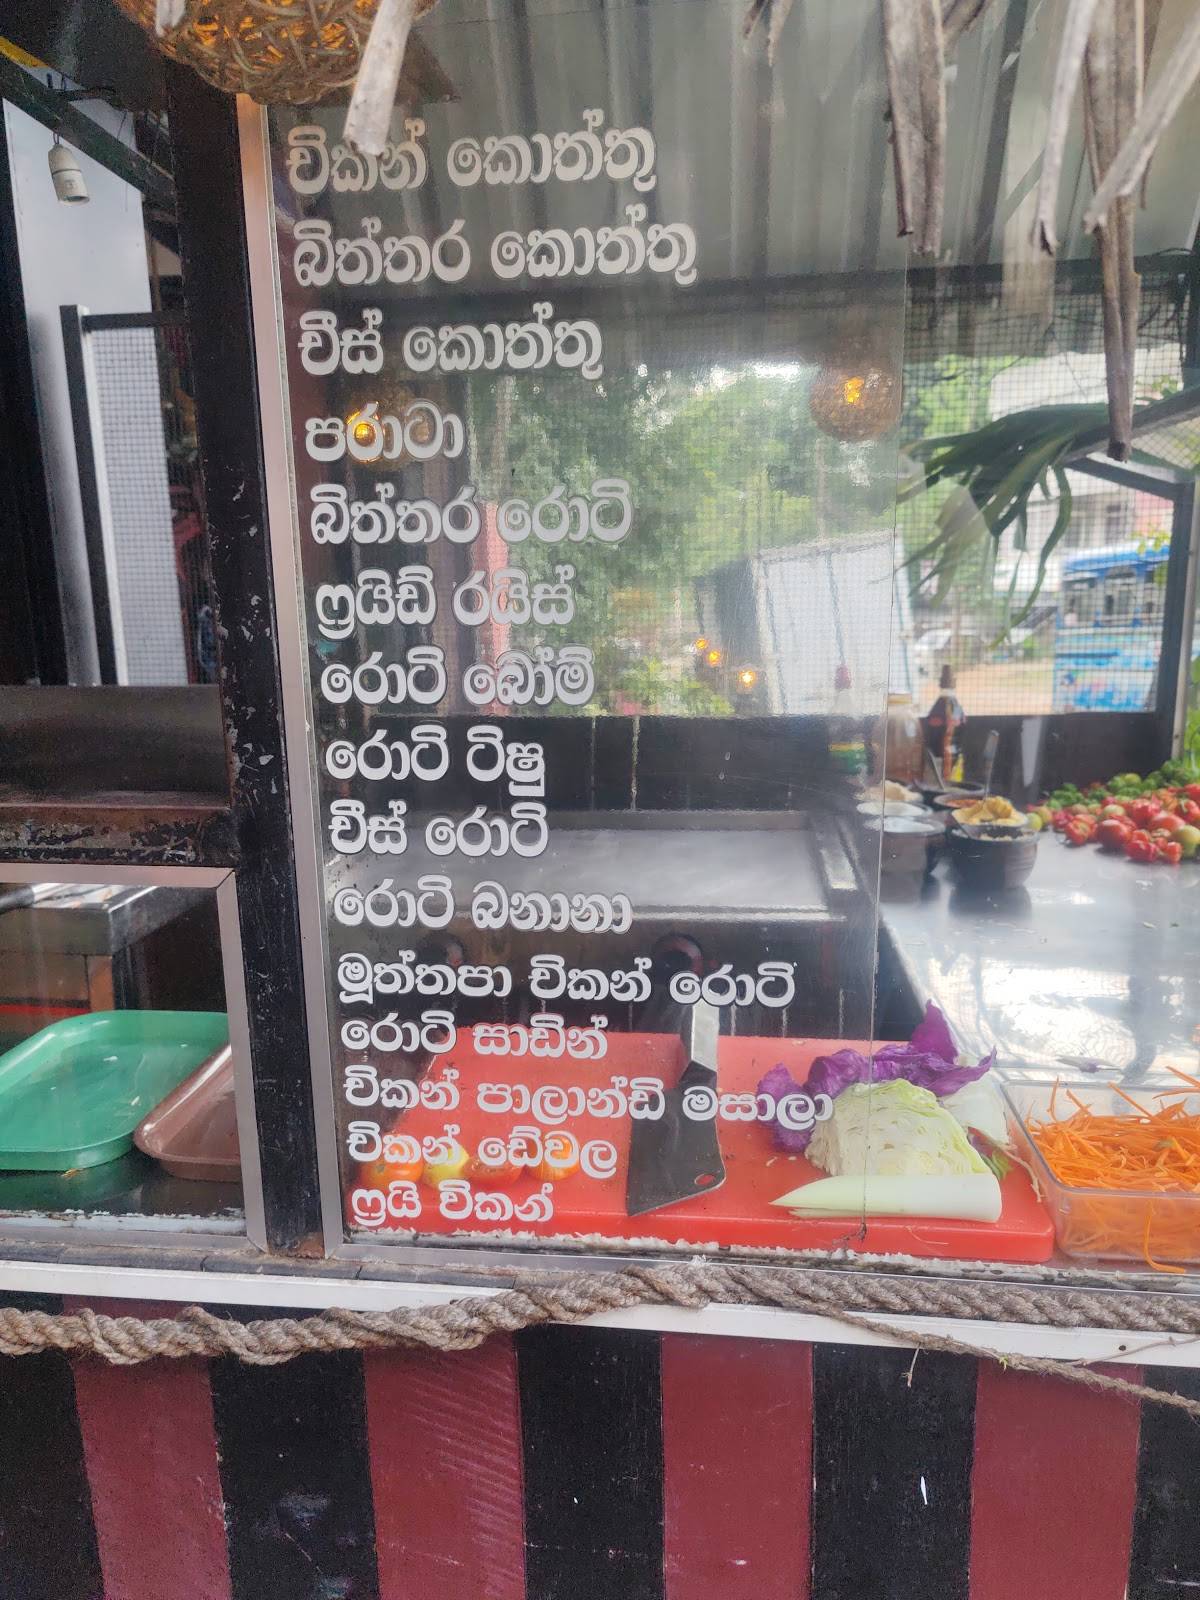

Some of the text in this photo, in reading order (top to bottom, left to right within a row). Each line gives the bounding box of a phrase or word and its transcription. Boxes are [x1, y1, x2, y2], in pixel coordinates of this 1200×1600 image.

[447, 109, 657, 192] කොත්තු
[294, 203, 697, 287] බිත්තර කොත්තු
[298, 302, 602, 380] චීස් කොත්තු
[305, 400, 464, 462] පරාටා
[310, 478, 633, 544] බිත්තර රොටි
[454, 564, 575, 626] රයිස්
[321, 645, 595, 705] රොටි බෝම්
[326, 724, 545, 797] රොටි ටිෂු
[328, 799, 549, 857] චීස් රොටි
[333, 875, 633, 934] රොටි බනානා
[528, 954, 652, 1002] චිකන්
[669, 962, 796, 1008] රොටි
[341, 1010, 608, 1059] රොටි සාඩින්
[343, 1064, 460, 1110] චිකන්
[683, 1086, 833, 1131] මසාලා
[346, 1121, 618, 1179] චිකන් ඩේවල
